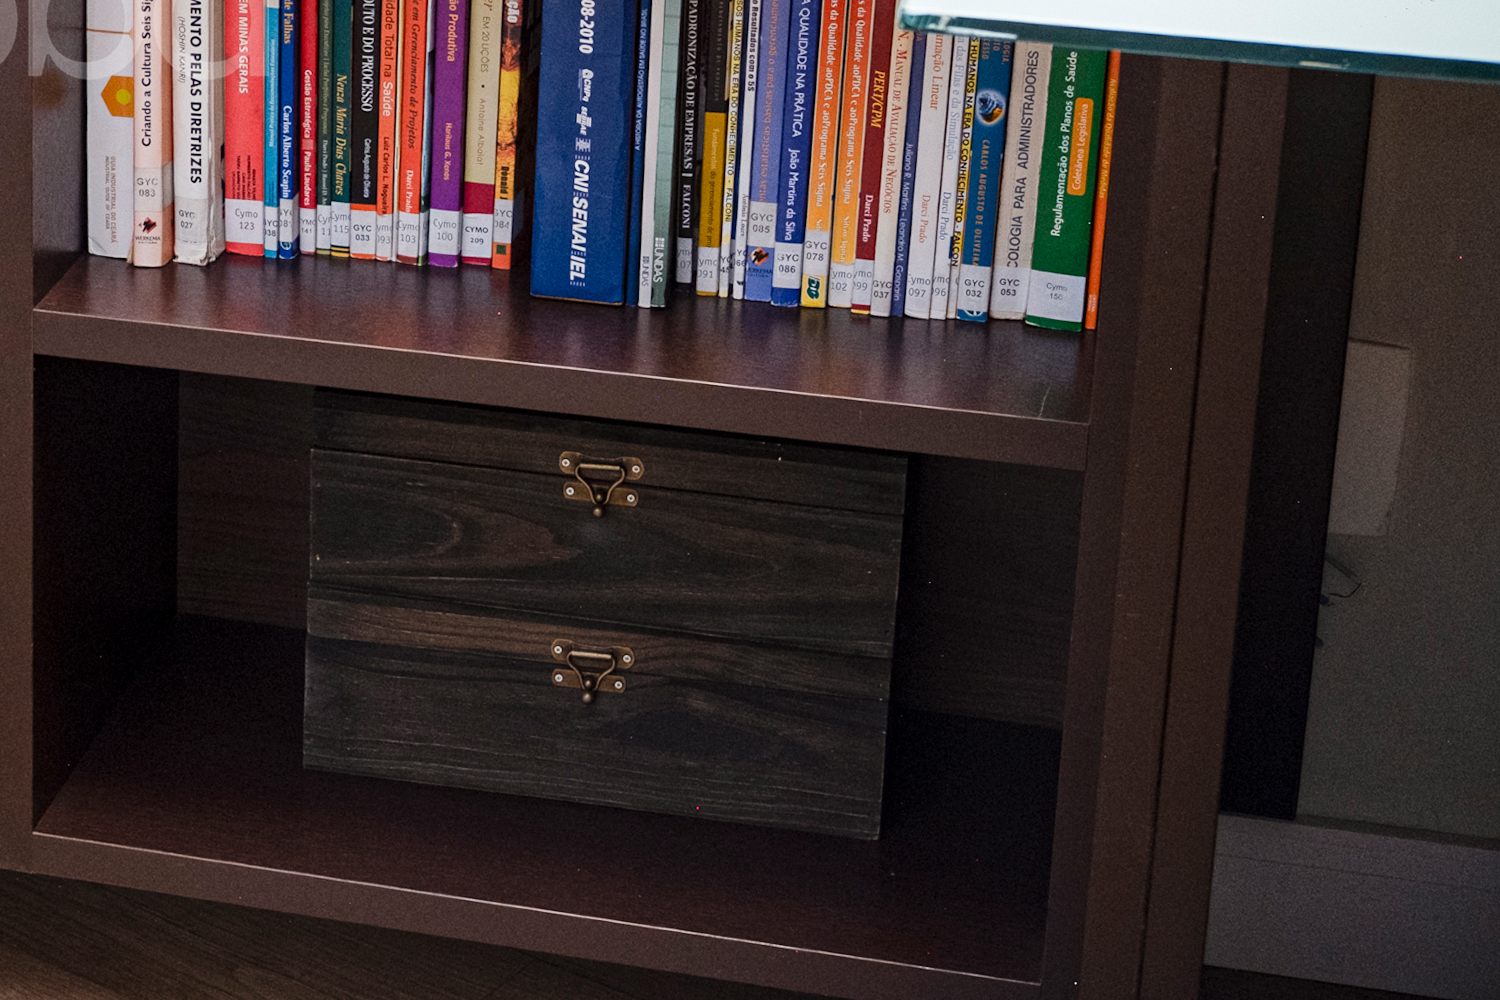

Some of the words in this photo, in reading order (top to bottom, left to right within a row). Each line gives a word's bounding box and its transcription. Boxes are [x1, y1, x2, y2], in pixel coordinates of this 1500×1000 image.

[141, 16, 151, 38] Seis
[238, 17, 247, 52] MINAS
[283, 13, 292, 43] Falhas
[446, 13, 458, 61] Produtiva
[795, 7, 810, 70] QUALIDADE
[362, 37, 373, 52] DO
[384, 34, 393, 61] Total
[685, 0, 699, 89] PADRONIZAÇÃO
[141, 42, 151, 86] Cultura
[190, 53, 201, 96] PELAS
[238, 55, 248, 93] GERAIS
[384, 64, 391, 78] na
[1065, 51, 1077, 82] Saúde
[336, 74, 346, 102] Neuza
[361, 55, 373, 111] PROCESSO
[795, 72, 805, 90] NA
[1063, 85, 1074, 97] de
[381, 81, 393, 116] Saúde
[685, 92, 694, 106] DE
[869, 70, 885, 128] PERT/CPM
[1017, 50, 1039, 169] ADMINISTRADORES
[141, 100, 151, 146] Criando
[282, 105, 291, 133] Carlos
[302, 97, 311, 137] Estratégica
[336, 106, 346, 134] Maria
[791, 92, 805, 137] PRÁTICA
[1060, 100, 1072, 133] Planos
[1076, 103, 1090, 146] Legislativa
[190, 102, 201, 183] DIRETRIZES
[282, 135, 291, 167] Alberto
[335, 137, 346, 159] Dias
[682, 109, 694, 169] EMPRESAS
[1059, 135, 1068, 154] dos
[786, 148, 800, 169] João
[1072, 148, 1084, 189] Coletânea
[136, 177, 159, 187] GYC
[280, 169, 290, 198] Scapin
[335, 163, 346, 194] Chaves
[572, 159, 589, 191] CNI
[786, 171, 798, 206] Martins
[138, 188, 156, 198] 083
[405, 191, 413, 212] Prado
[681, 184, 691, 228] FALCONI
[1013, 176, 1026, 208] PARA
[1050, 155, 1069, 236] Regulamentação
[180, 220, 193, 229] 027
[234, 208, 259, 220] Cymo
[239, 221, 255, 231] 123
[353, 224, 372, 233] GYC
[569, 197, 588, 251] SENAI
[785, 208, 795, 219] da
[355, 234, 370, 242] 033
[784, 221, 795, 241] Silva
[569, 255, 585, 282] IEL
[652, 247, 663, 282] UNIDAS
[999, 278, 1020, 287] GYC
[1000, 288, 1017, 297] 053
